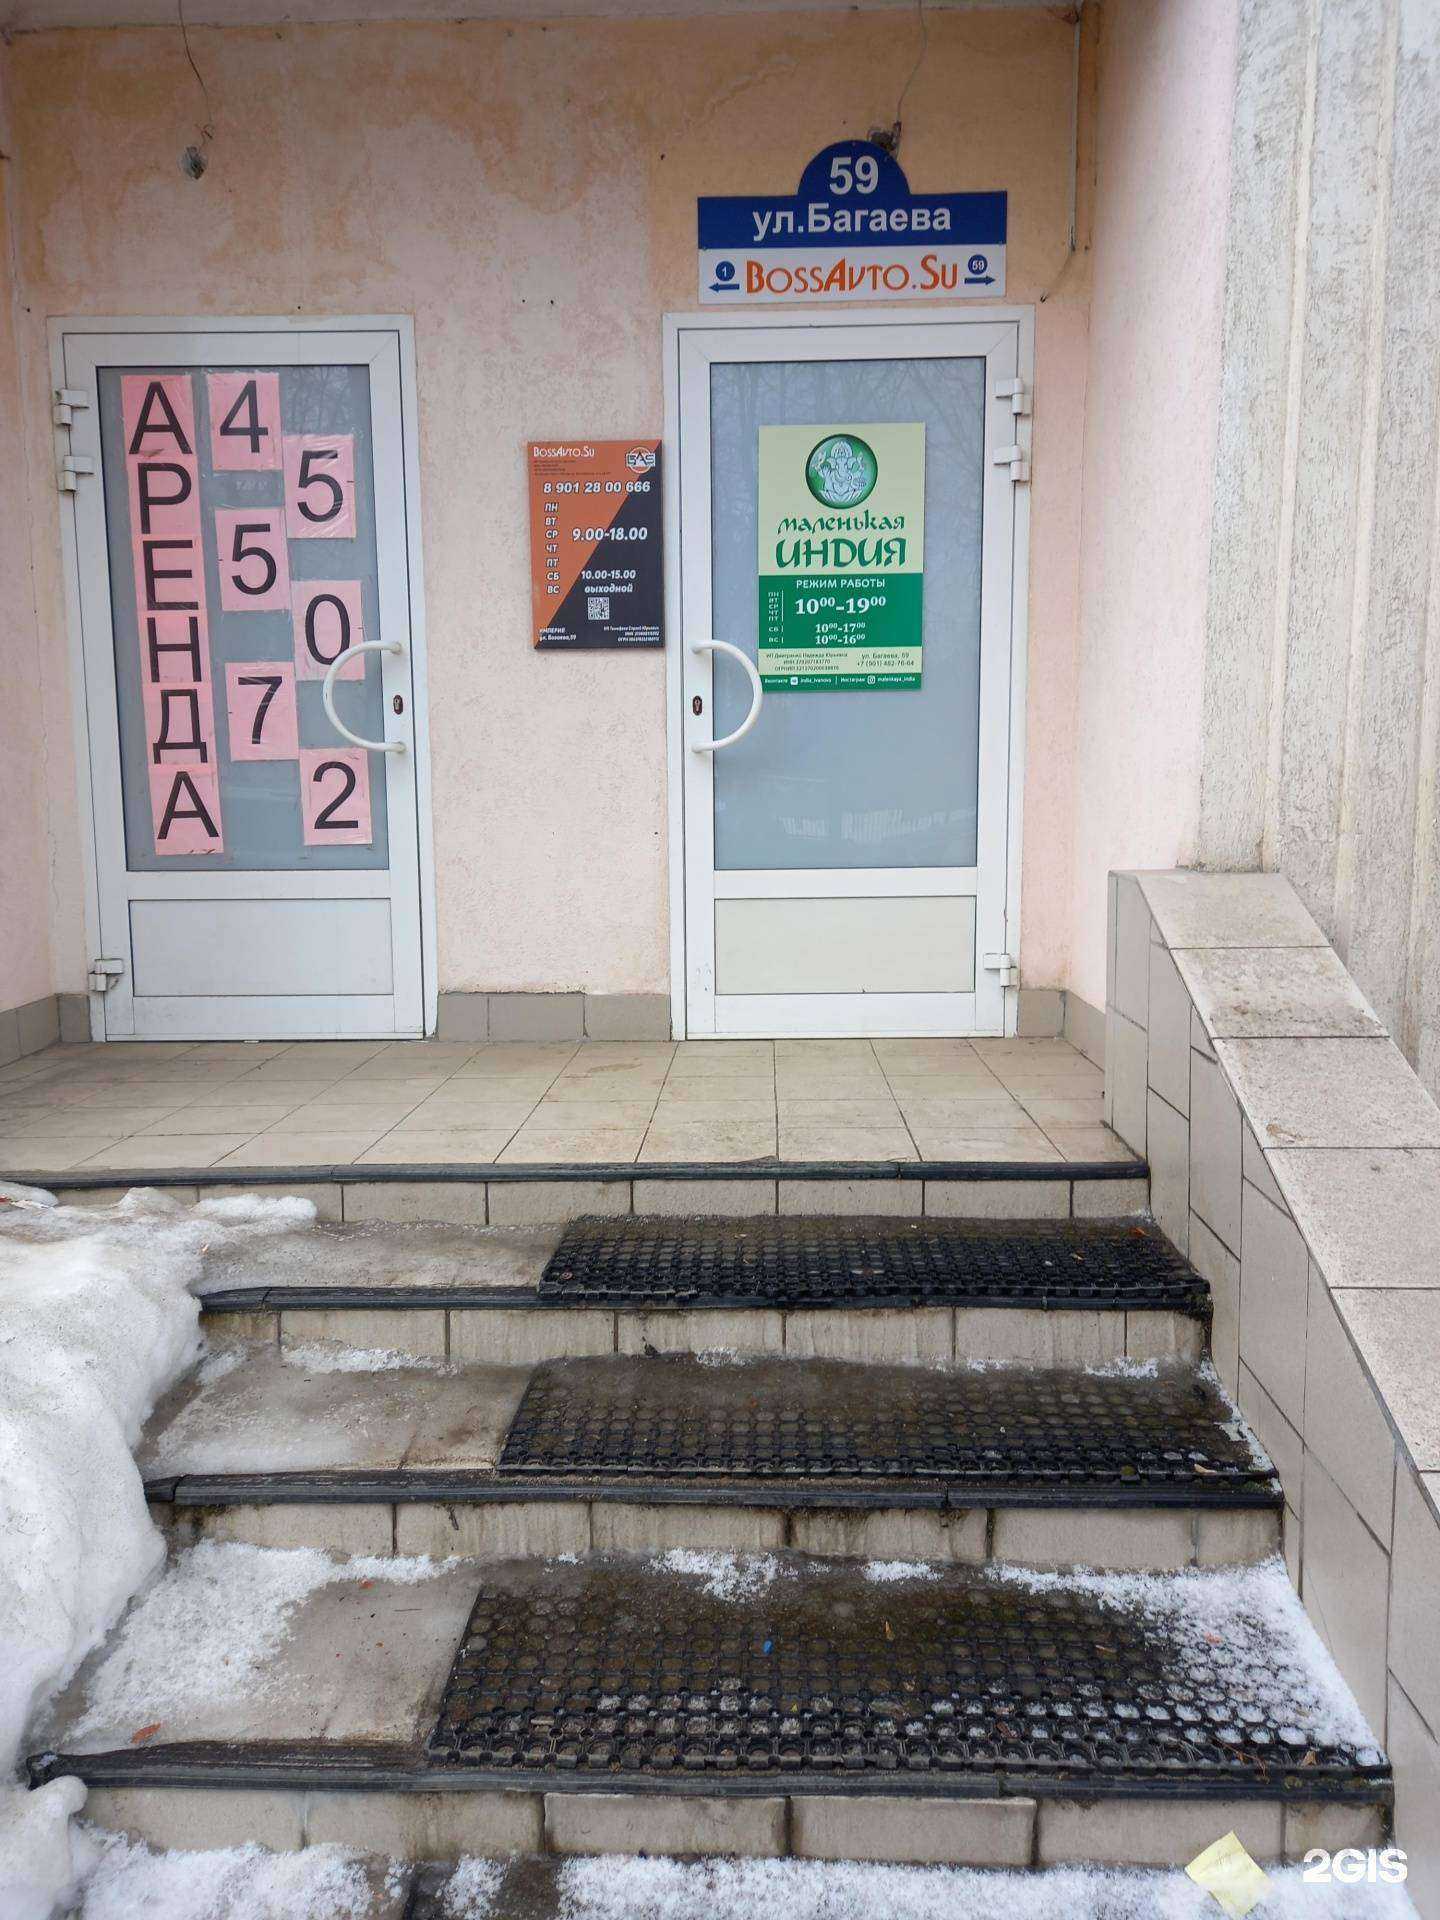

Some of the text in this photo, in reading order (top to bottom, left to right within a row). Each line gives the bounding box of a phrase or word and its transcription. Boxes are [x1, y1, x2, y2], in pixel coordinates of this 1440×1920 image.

[829, 157, 879, 195] 59
[753, 203, 951, 241] ул.Багаева
[722, 266, 728, 277] 1
[543, 481, 651, 493] 8 901 28 00 666
[545, 503, 558, 511] ПН
[545, 517, 557, 525] ВТ
[778, 509, 905, 534] маленькая
[545, 527, 648, 541] СР 9.00-18.00
[546, 544, 558, 552] ЧТ
[776, 537, 906, 568] ИНДИЯ
[546, 559, 558, 567] ПТ
[547, 570, 636, 580] СБ 10.00-15.00
[584, 583, 633, 593] выходной
[796, 578, 885, 588] РЕЖИМ РАБОТЫ
[129, 381, 220, 840] АРЕНДА
